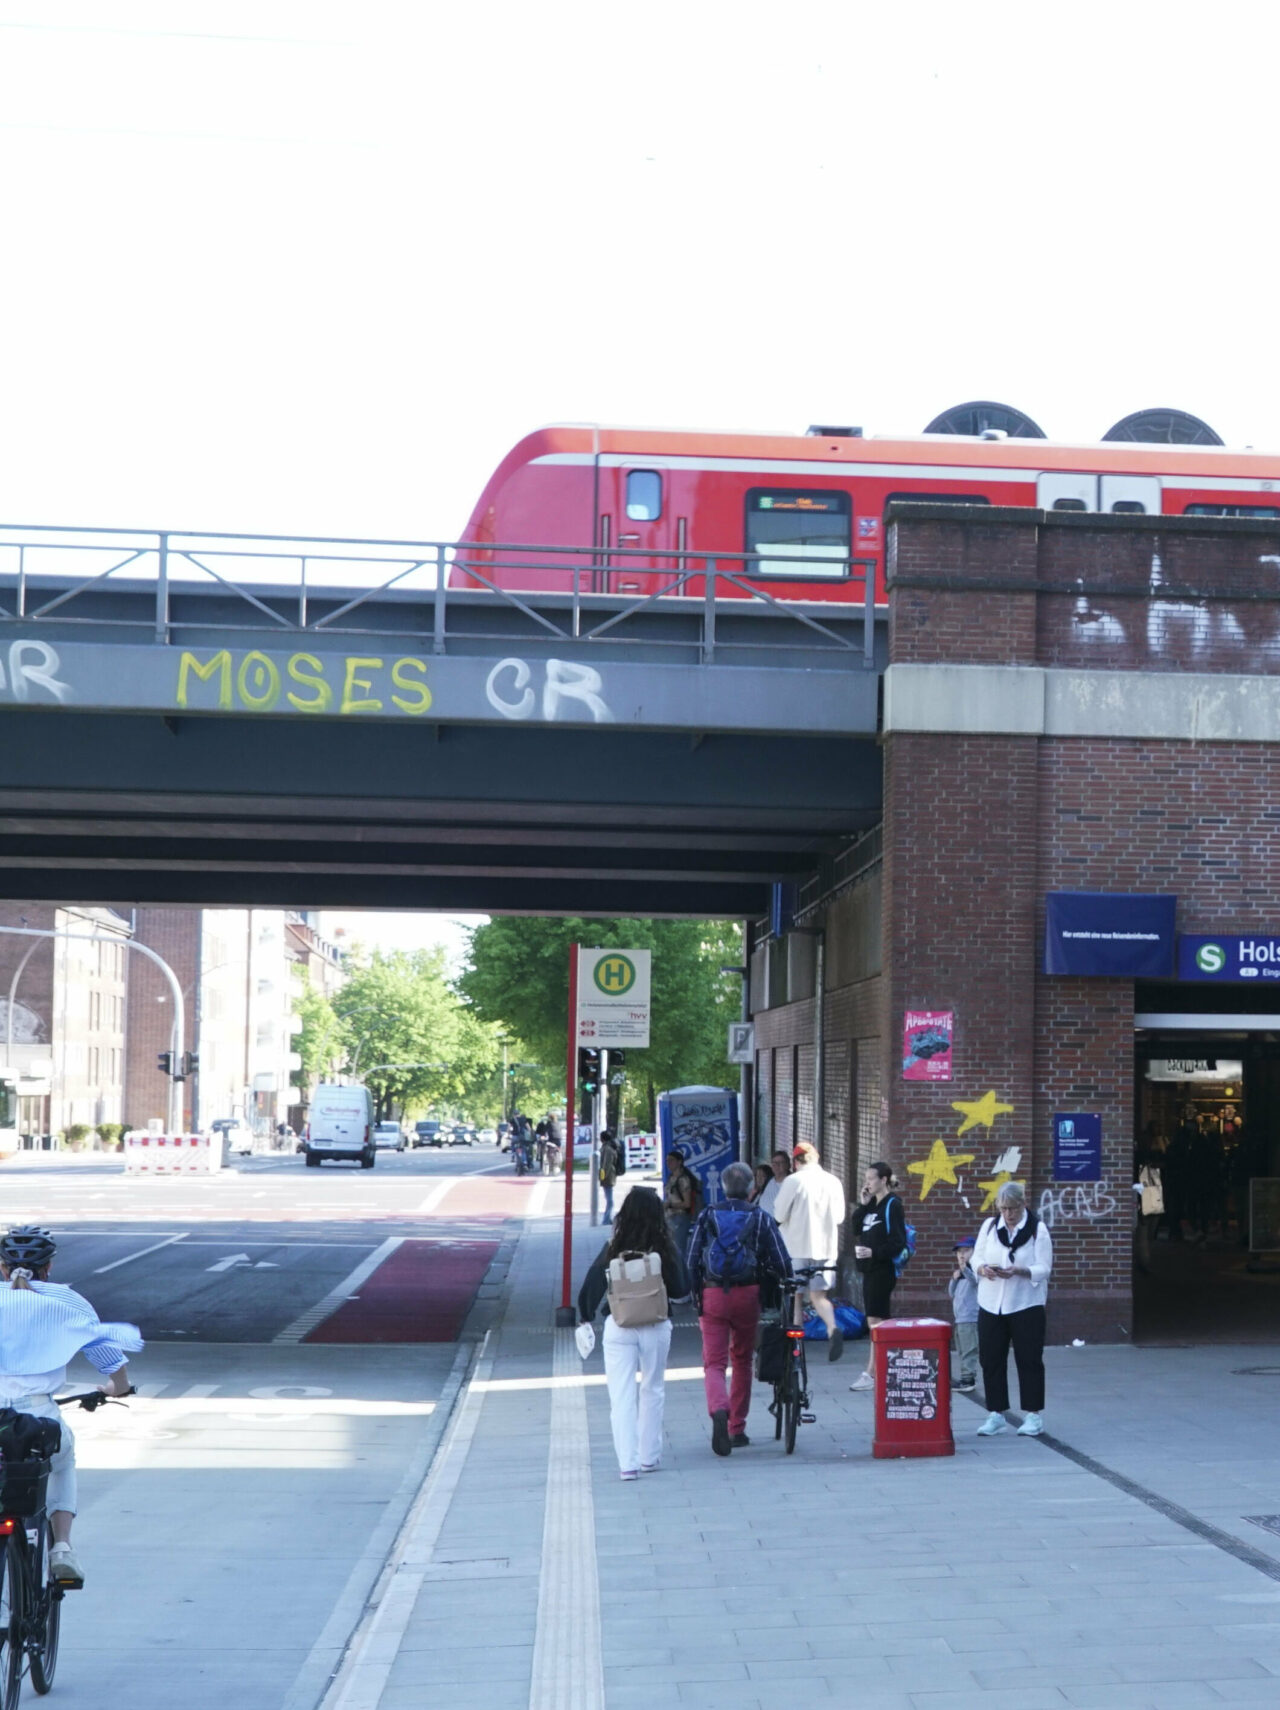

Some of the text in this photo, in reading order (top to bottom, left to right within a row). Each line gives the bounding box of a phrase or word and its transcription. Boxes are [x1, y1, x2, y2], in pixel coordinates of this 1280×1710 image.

[176, 649, 433, 716] MOSES
[486, 656, 614, 723] CR
[605, 963, 624, 985] H
[1037, 1181, 1116, 1228] ACAB
